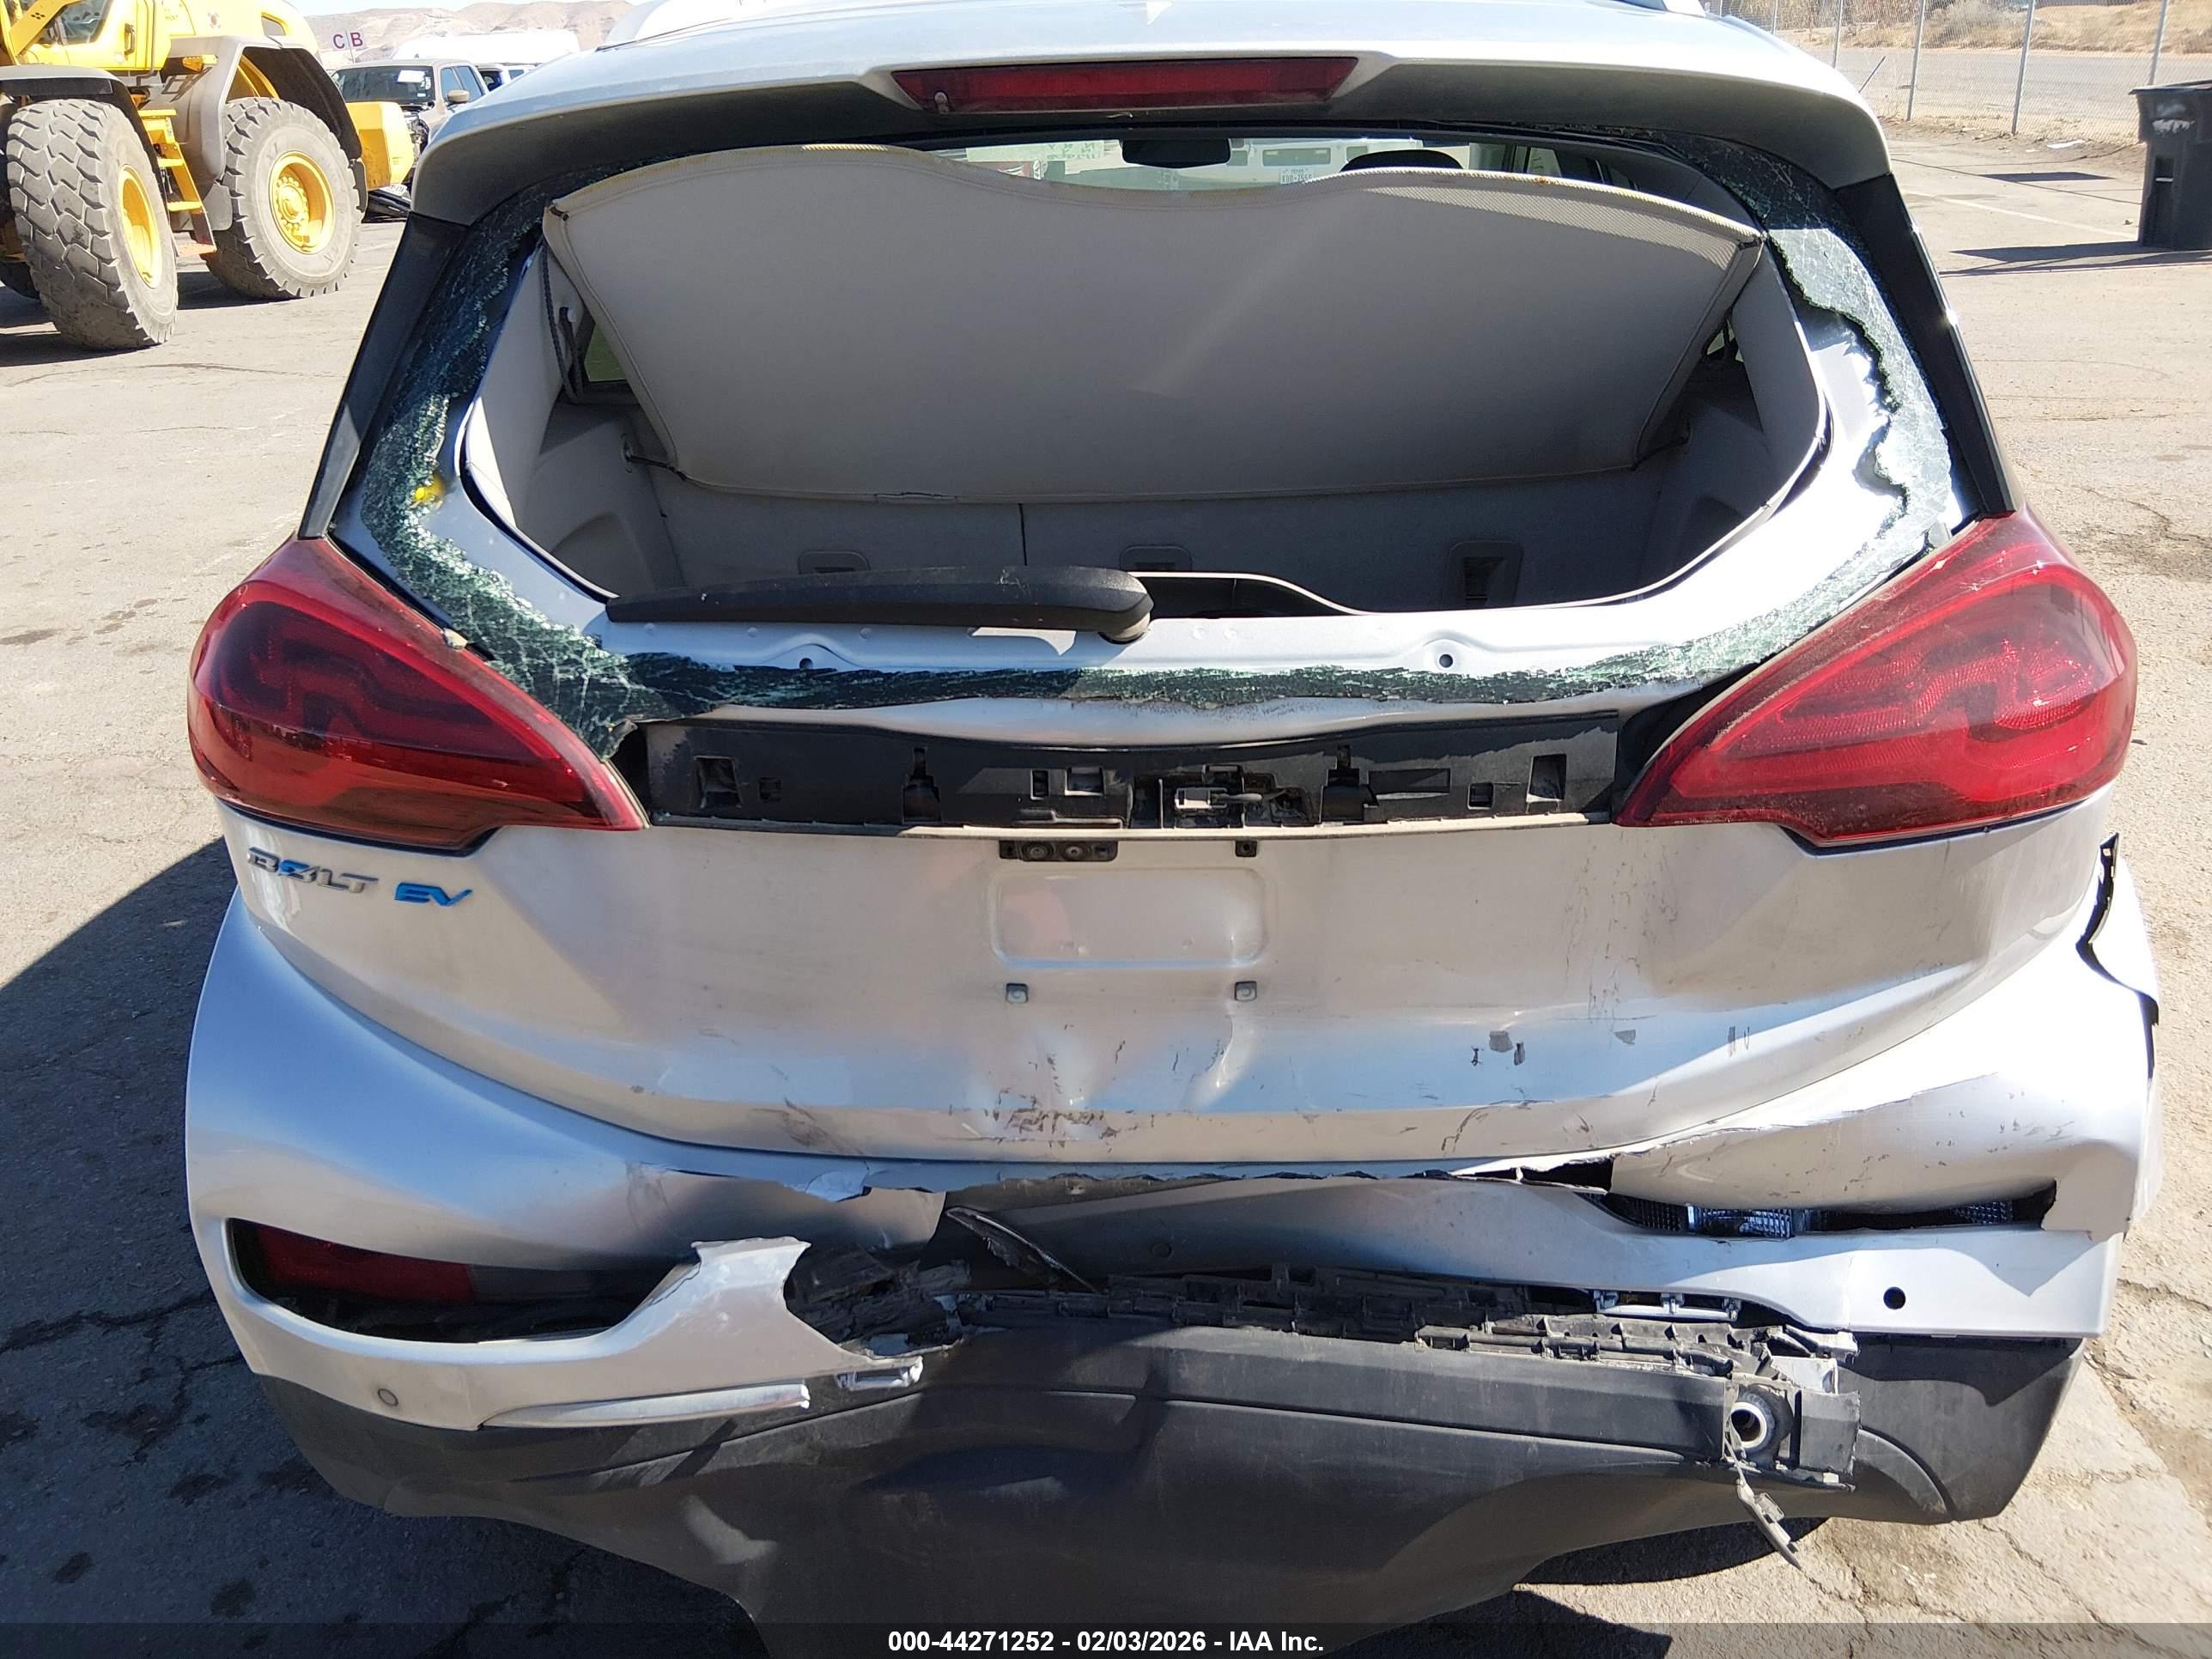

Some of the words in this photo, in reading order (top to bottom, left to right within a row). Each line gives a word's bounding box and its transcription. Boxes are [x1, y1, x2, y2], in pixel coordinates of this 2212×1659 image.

[332, 33, 345, 49] C
[349, 32, 363, 47] B
[394, 882, 472, 907] EV
